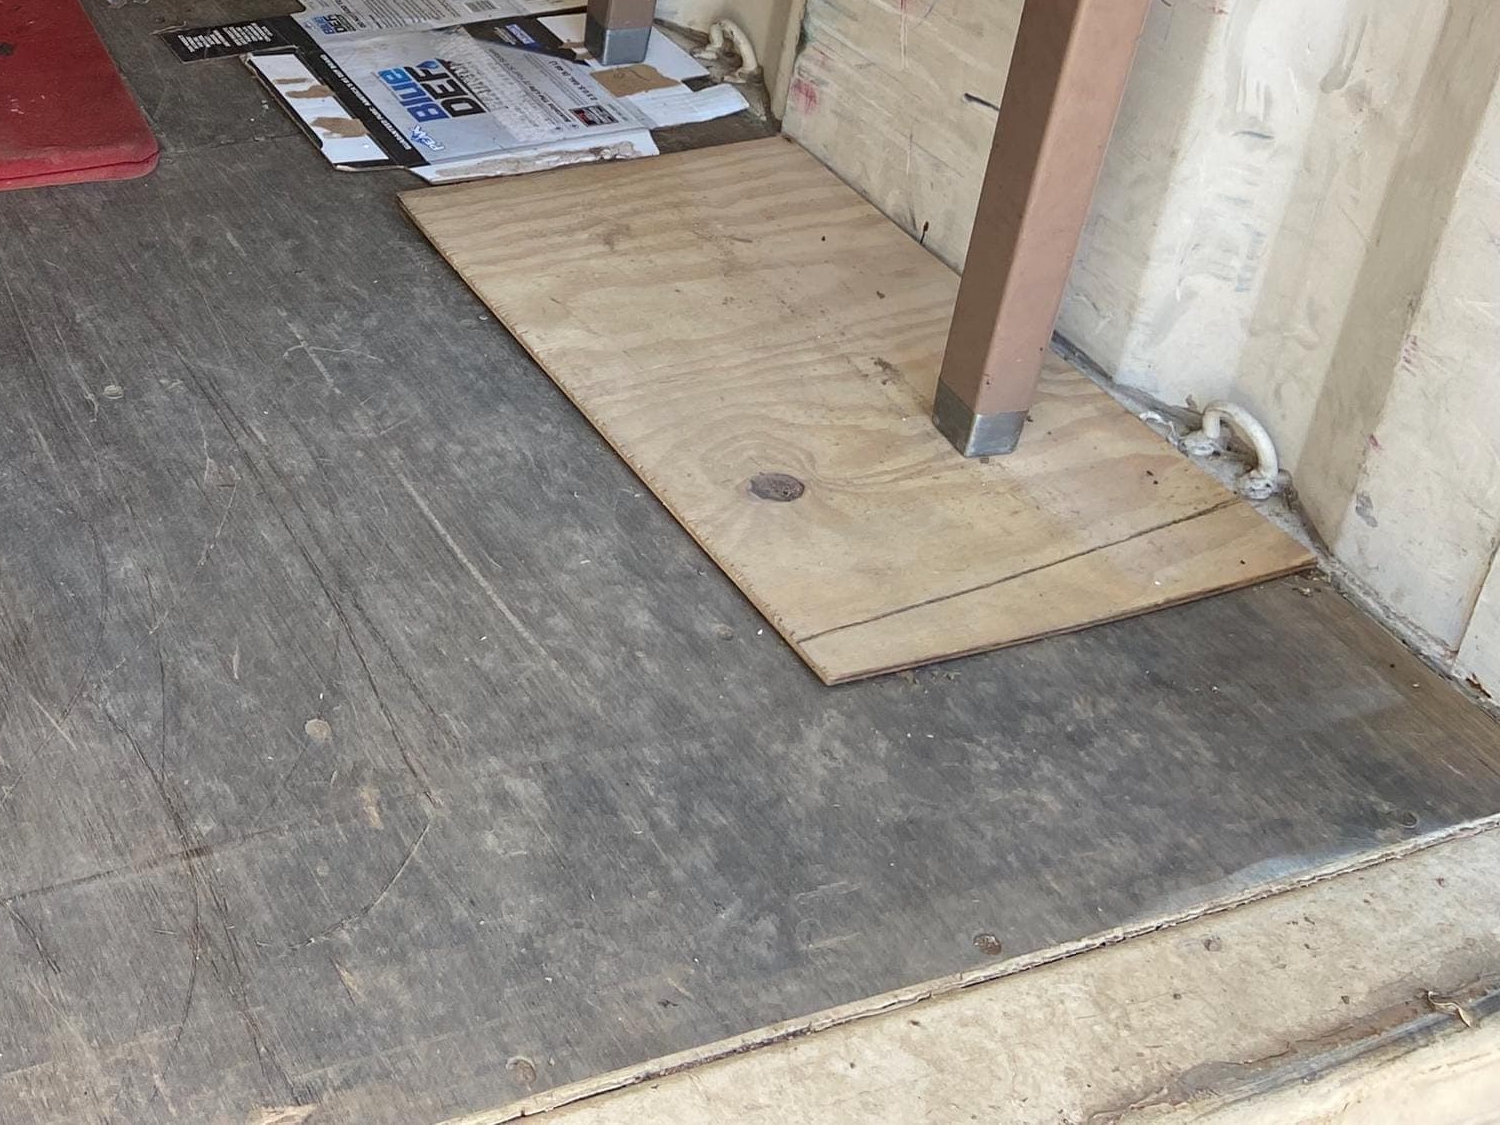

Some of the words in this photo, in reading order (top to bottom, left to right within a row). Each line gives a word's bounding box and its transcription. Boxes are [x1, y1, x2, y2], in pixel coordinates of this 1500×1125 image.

[378, 67, 451, 123] Blue
[403, 66, 487, 118] DEF
[411, 124, 445, 152] PEAK
